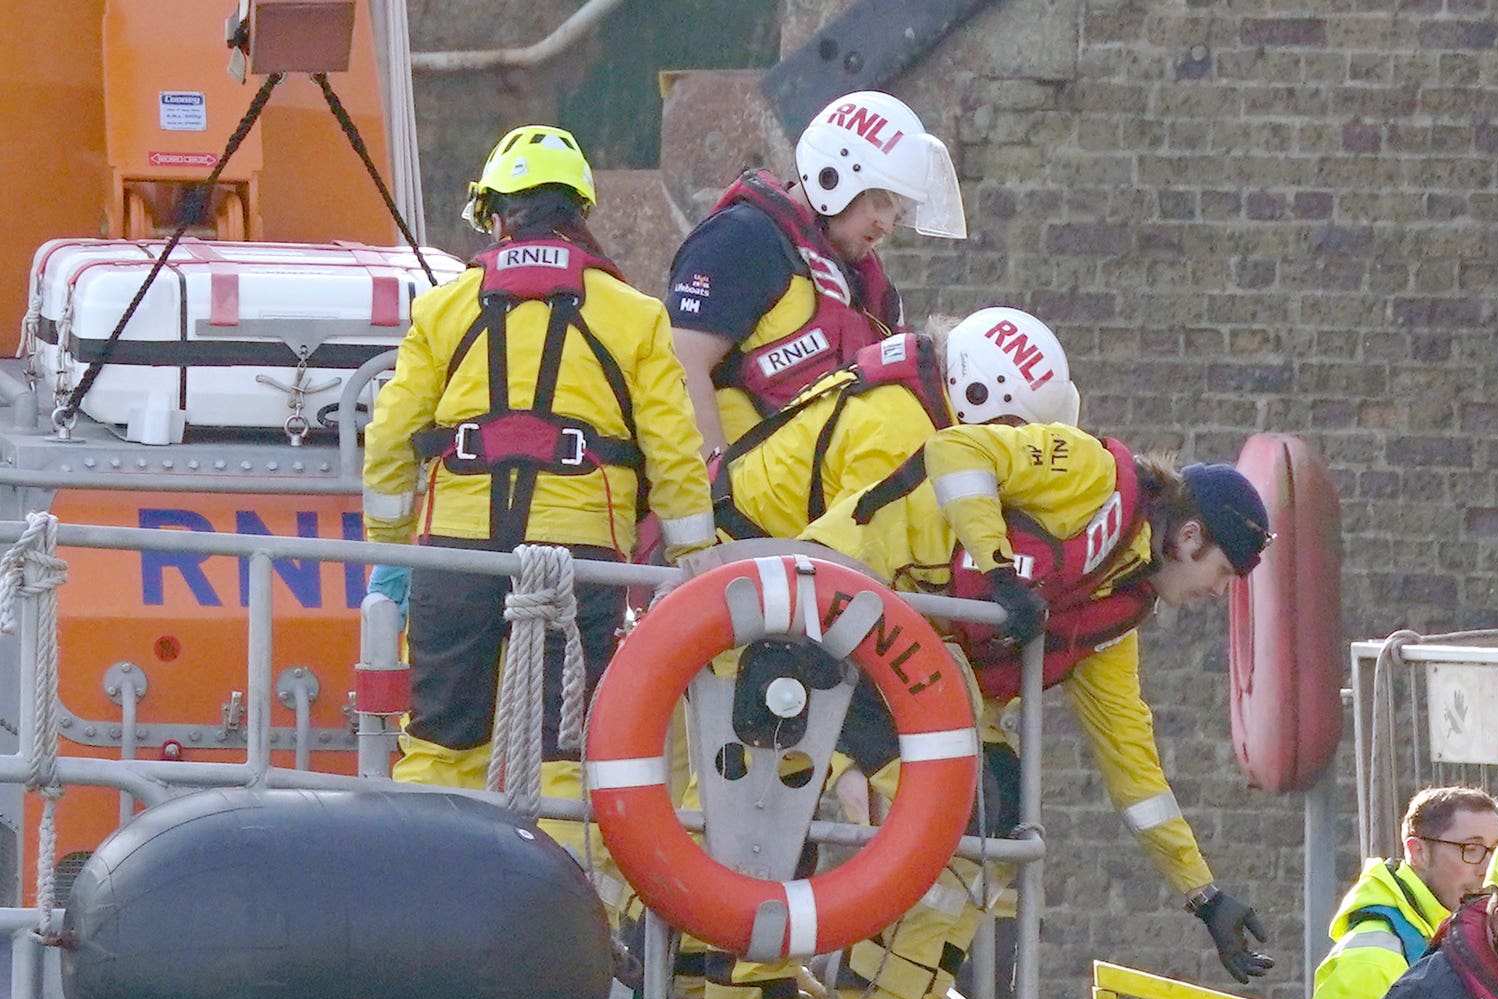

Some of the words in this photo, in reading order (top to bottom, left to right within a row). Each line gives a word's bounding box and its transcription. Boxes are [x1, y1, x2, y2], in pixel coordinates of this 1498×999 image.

[827, 102, 905, 155] RNLI
[506, 248, 559, 265] RNLI
[674, 282, 710, 297] Lifeboats
[768, 334, 820, 370] RNLI
[984, 319, 1054, 392] RNLI
[1050, 433, 1069, 472] NLI
